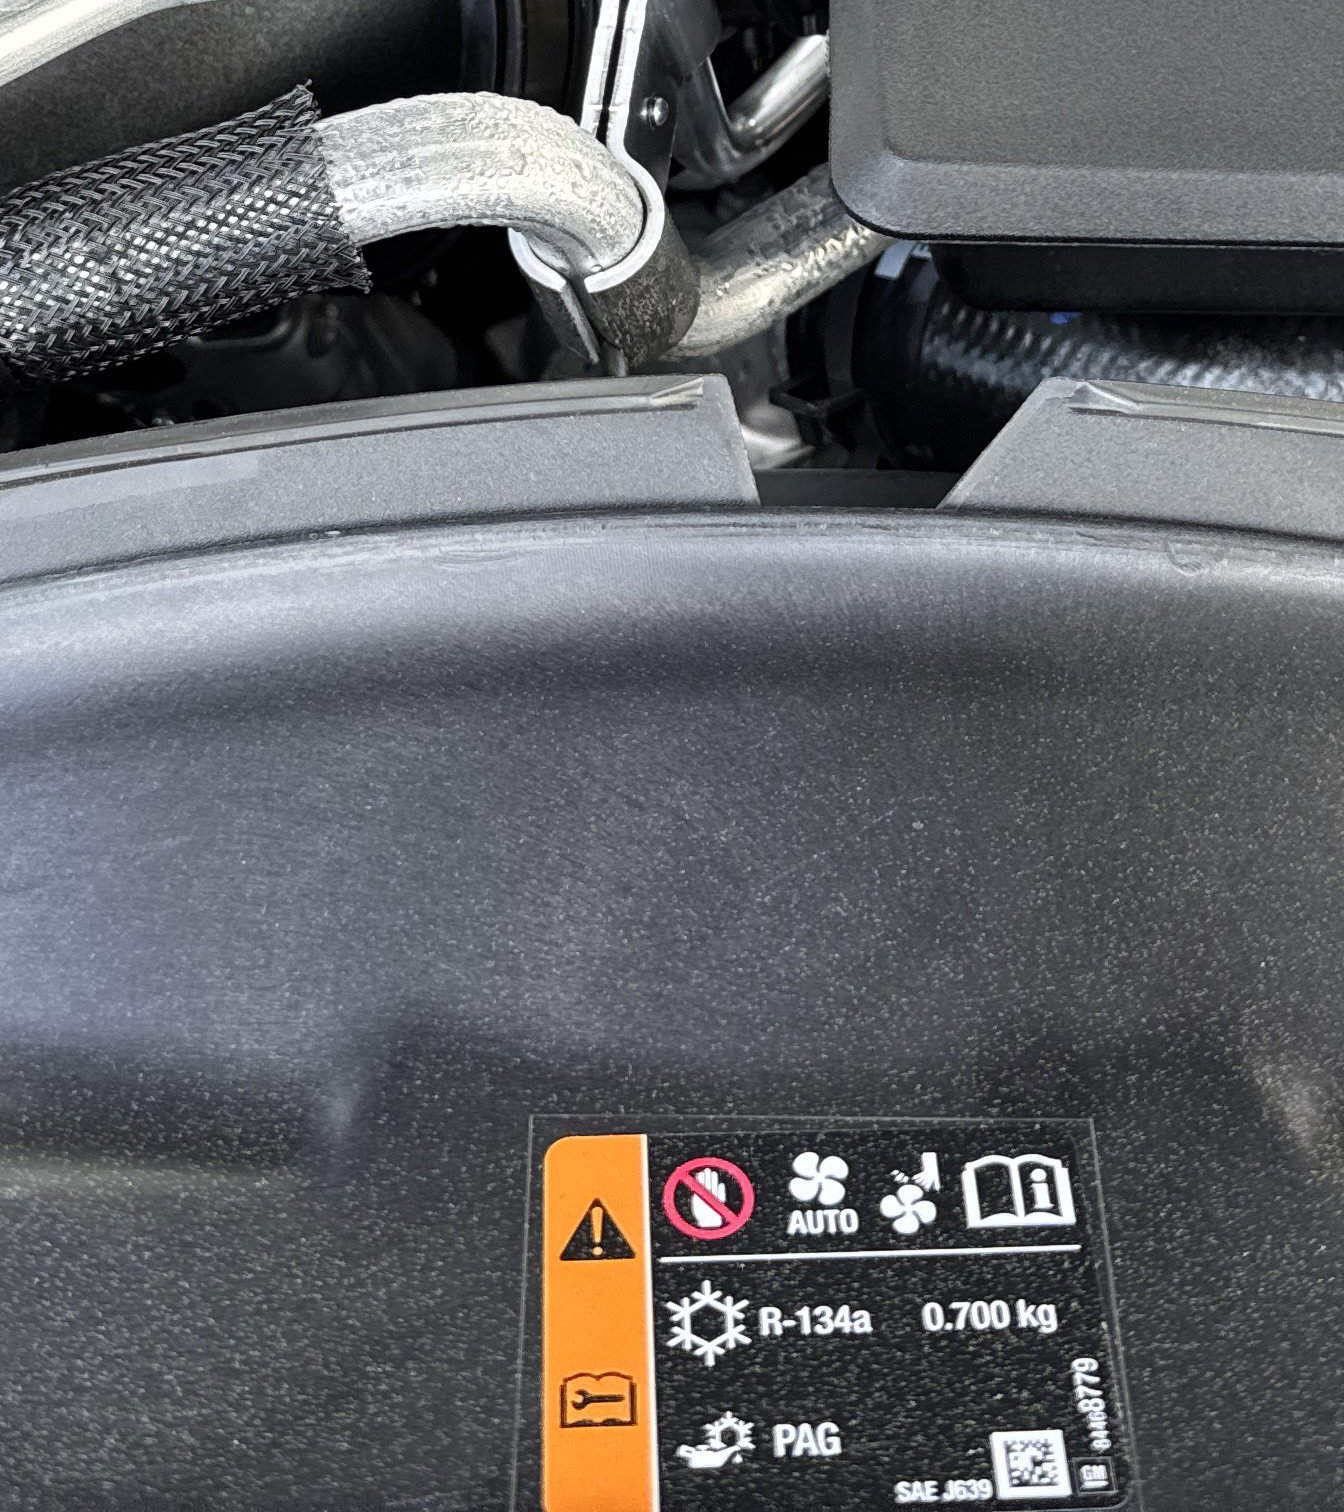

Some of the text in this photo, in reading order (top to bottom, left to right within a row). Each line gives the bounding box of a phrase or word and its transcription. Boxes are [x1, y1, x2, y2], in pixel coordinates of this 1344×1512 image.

[787, 1208, 859, 1235] AUTO
[759, 1298, 1058, 1336] R-134a 0.700 kg
[773, 1422, 842, 1457] PAG
[894, 1478, 994, 1504] SAE J639
